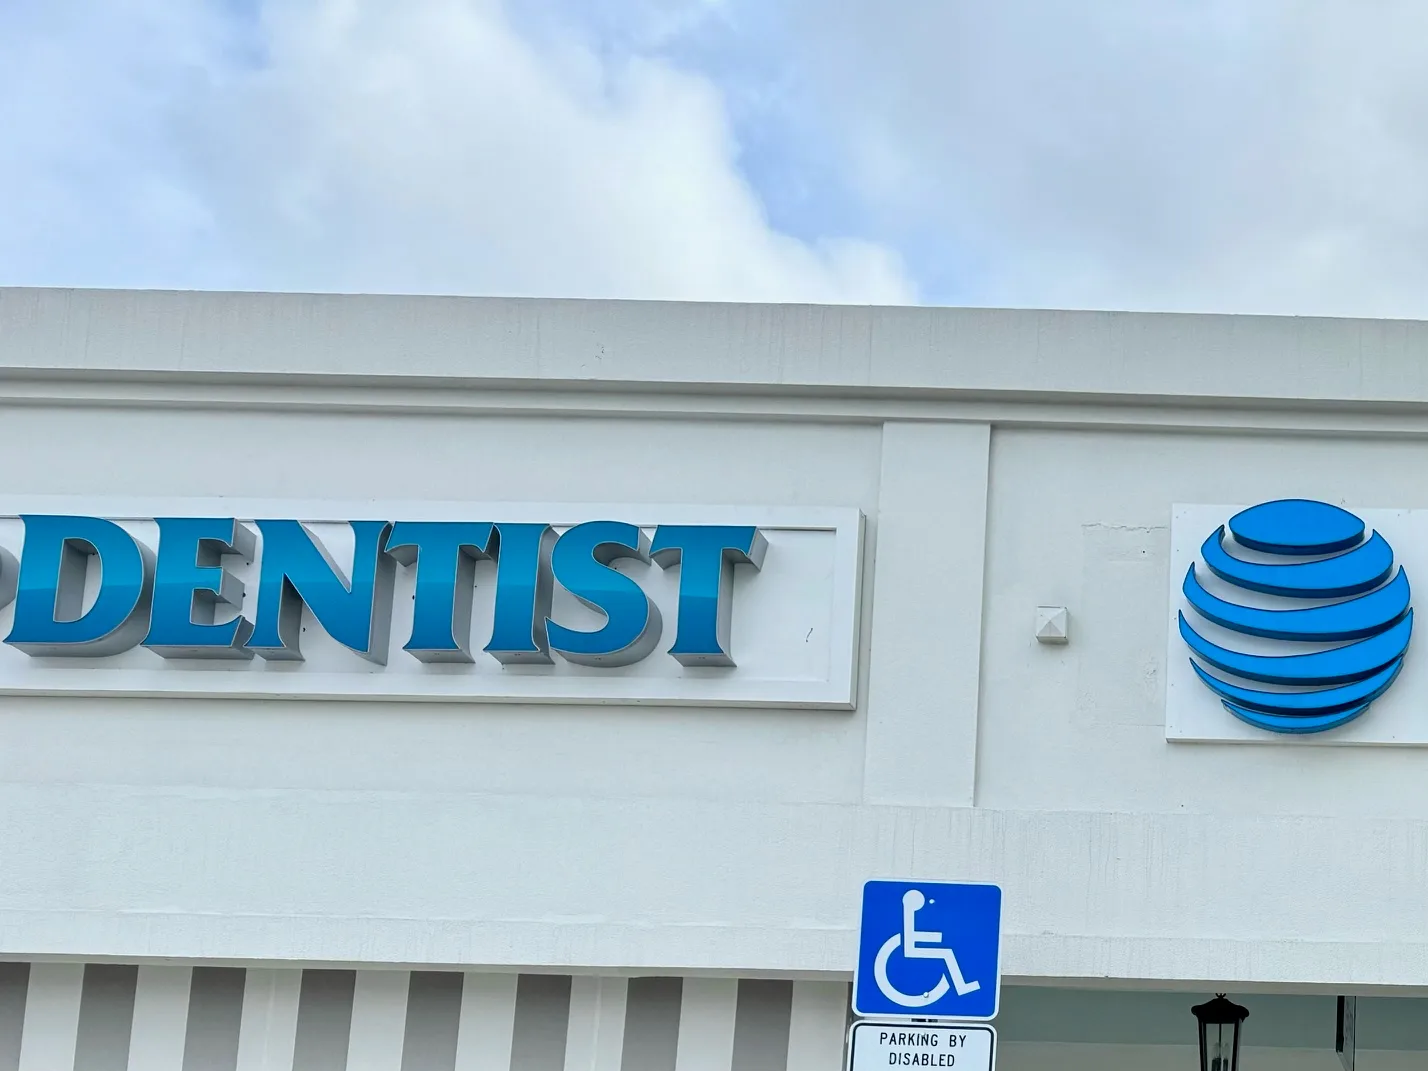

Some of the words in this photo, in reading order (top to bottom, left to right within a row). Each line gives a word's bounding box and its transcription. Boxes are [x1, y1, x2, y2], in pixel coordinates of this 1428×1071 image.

[2, 514, 768, 667] DENTIST
[879, 1031, 939, 1048] PARKING
[949, 1034, 967, 1048] BY
[889, 1053, 955, 1068] DISABLED
